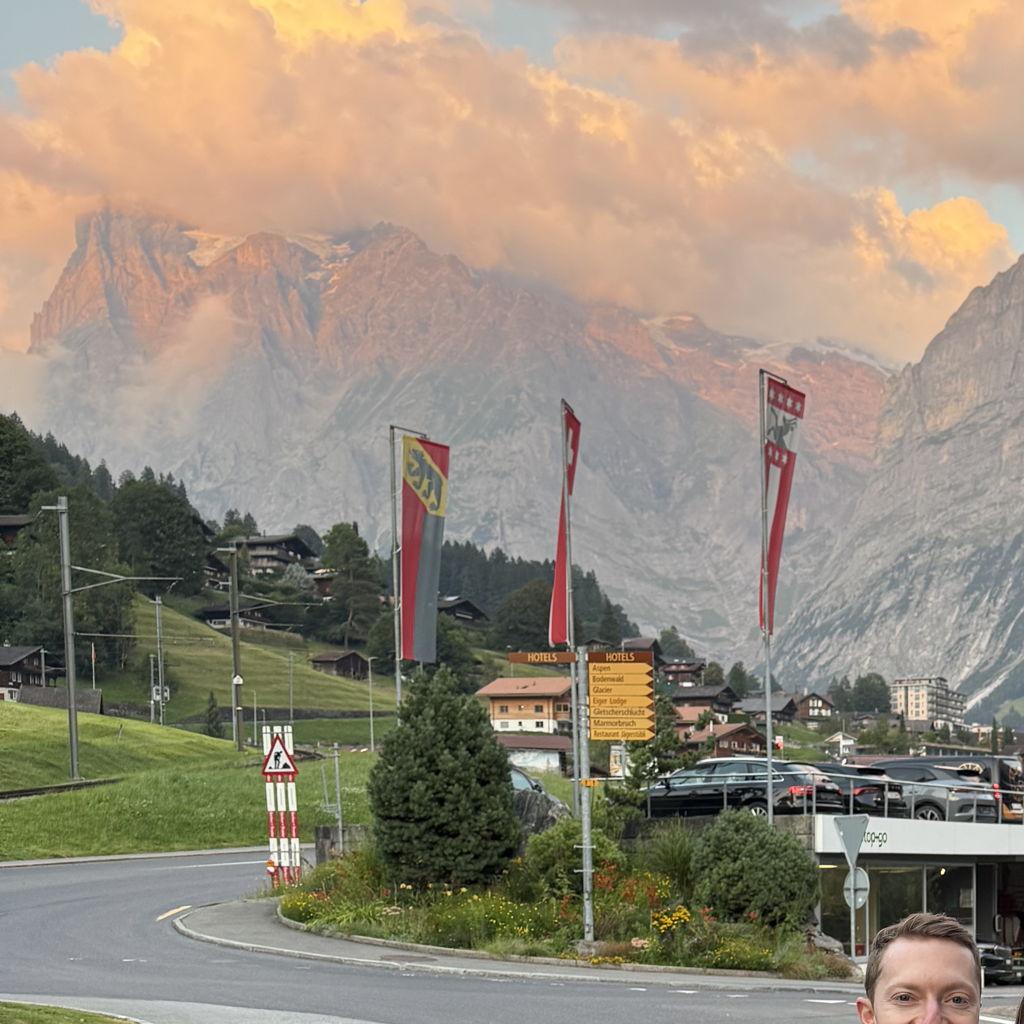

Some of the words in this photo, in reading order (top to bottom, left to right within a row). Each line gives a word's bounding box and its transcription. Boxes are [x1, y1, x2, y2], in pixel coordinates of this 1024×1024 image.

[527, 653, 558, 662] HOTELS
[606, 652, 635, 662] HOTELS
[592, 664, 611, 673] Aspen
[592, 675, 624, 683] Bodenwald
[592, 697, 607, 706] Eiger
[609, 697, 627, 706] Lodge
